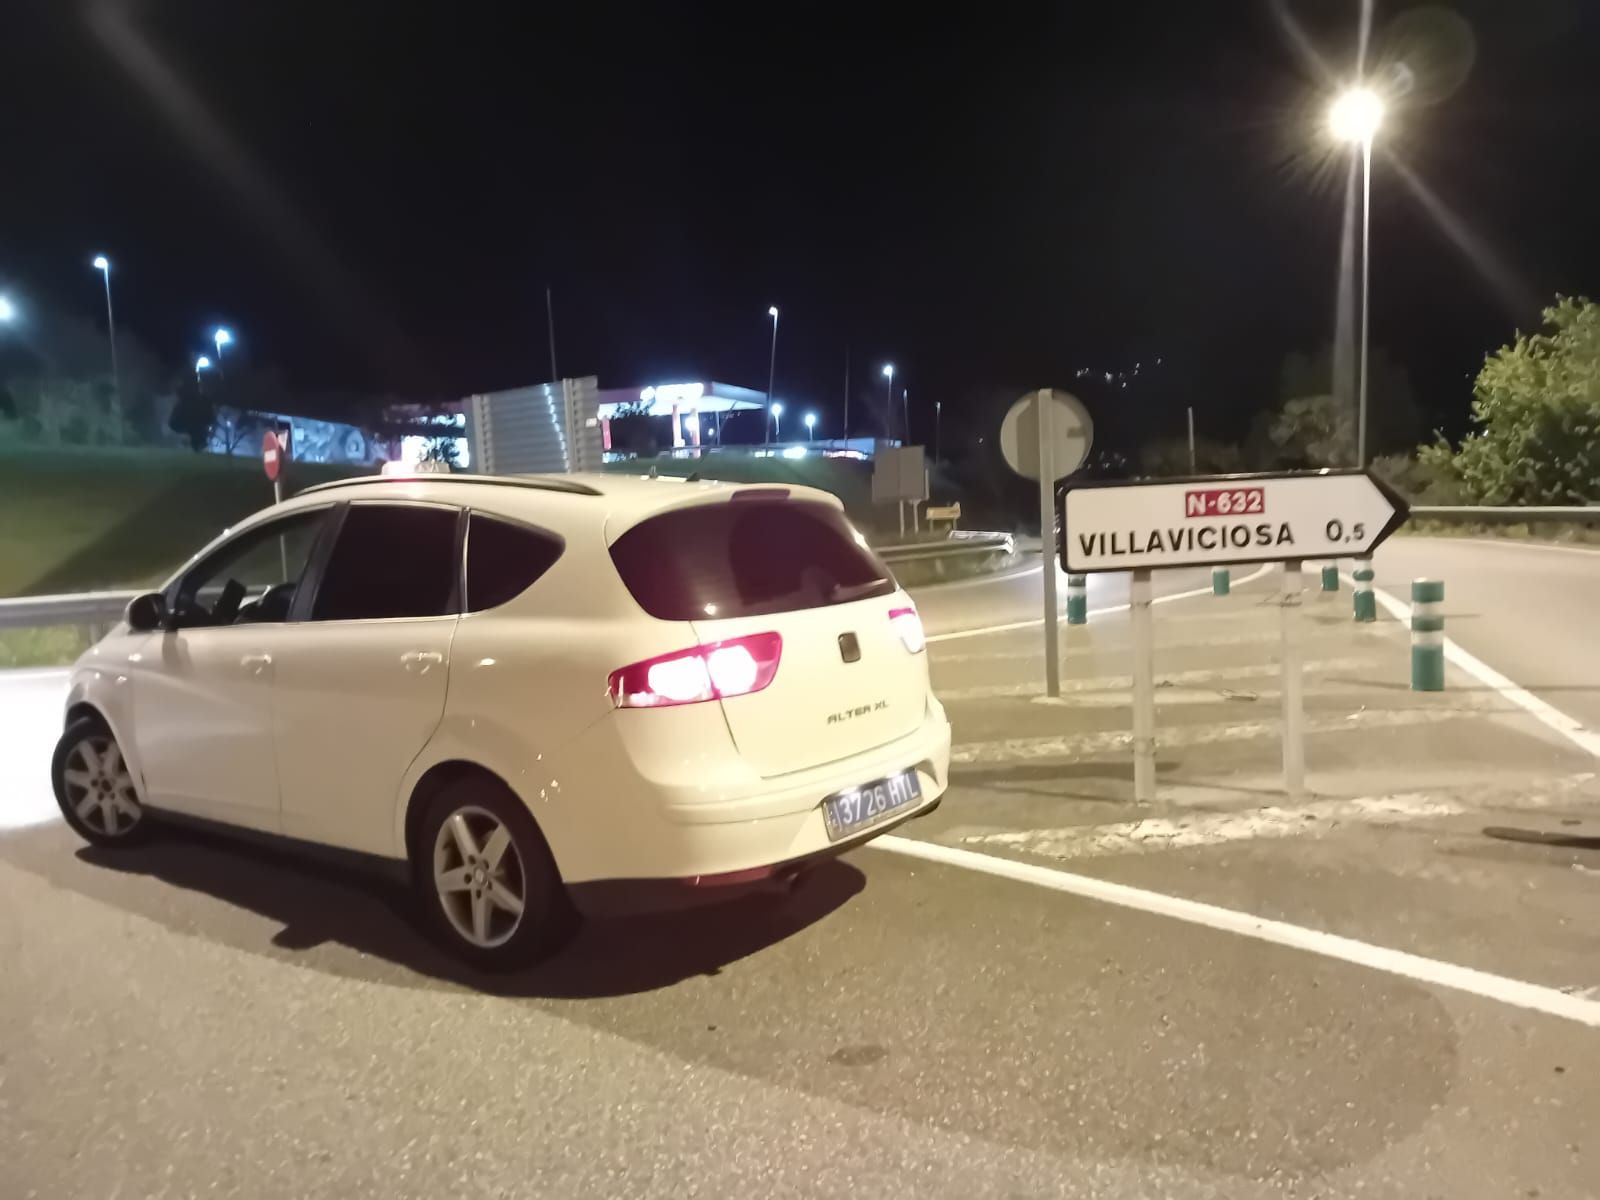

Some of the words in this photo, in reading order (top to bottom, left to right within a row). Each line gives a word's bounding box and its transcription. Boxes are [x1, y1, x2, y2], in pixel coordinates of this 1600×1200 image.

[1186, 490, 1262, 517] N-632
[1079, 522, 1295, 557] VILLAVICIOSA
[874, 700, 889, 711] XL
[839, 785, 886, 824] 3726
